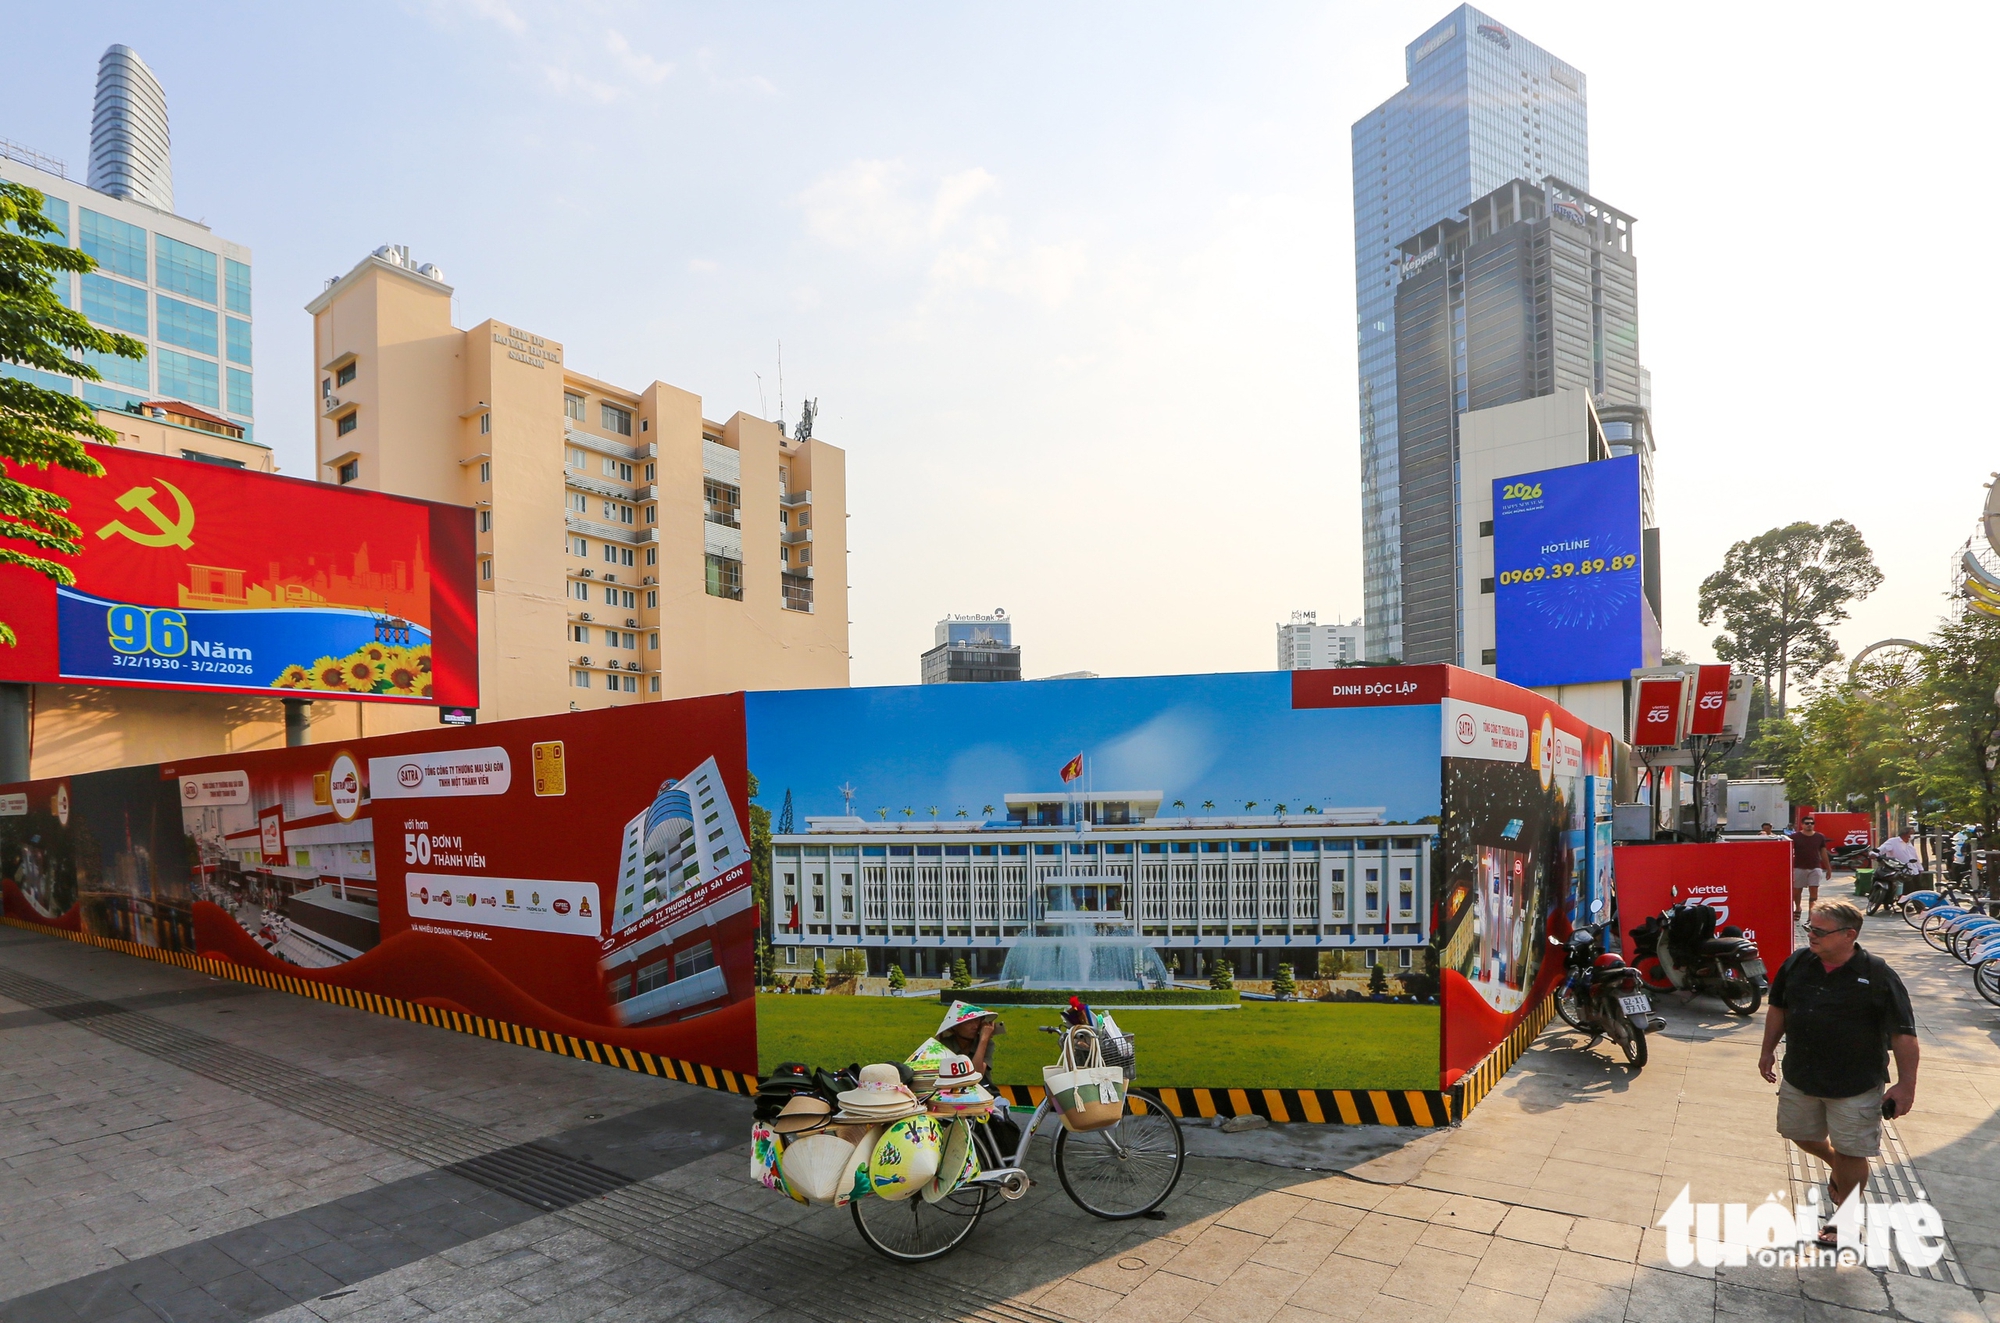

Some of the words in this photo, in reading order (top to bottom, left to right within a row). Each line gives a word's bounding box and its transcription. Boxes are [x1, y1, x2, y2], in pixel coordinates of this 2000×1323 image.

[1402, 246, 1437, 274] Keppel
[508, 327, 530, 343] KIM
[493, 333, 527, 352] ROYAL
[529, 345, 560, 364] HOTEL
[508, 350, 545, 369] SAIGON
[1502, 482, 1543, 501] 2026
[1541, 539, 1591, 555] HOTLINE
[1499, 553, 1637, 586] 0969.39.89.89
[954, 613, 995, 622] VietinBank
[1303, 611, 1317, 619] MB
[106, 604, 189, 658] 96
[190, 639, 253, 662] Năm
[112, 654, 181, 670] 3/2/1930
[191, 660, 254, 675] 3/2/2026
[1332, 685, 1362, 696] DINH
[1364, 681, 1393, 697] ĐỘC
[1395, 680, 1418, 696] LẬP
[1699, 695, 1723, 709] 5G
[1647, 709, 1669, 723] 5G
[1458, 720, 1474, 737] SATRA
[401, 770, 419, 781] SATRA
[404, 819, 414, 830] với
[415, 819, 429, 830] hơn
[432, 834, 452, 848] ĐƠN
[452, 836, 462, 851] VỊ
[1843, 834, 1869, 847] 5G
[404, 833, 431, 866] 50
[433, 851, 463, 867] THÀNH
[464, 852, 486, 868] VIÊN
[1687, 885, 1729, 894] viettel
[623, 924, 638, 937] TỔNG
[638, 915, 654, 928] CÔNG
[655, 910, 664, 920] TY
[665, 895, 692, 915] THƯƠNG
[693, 886, 709, 899] MẠI
[710, 878, 724, 891] SÀI
[725, 867, 744, 882] GÒN
[411, 923, 418, 931] VÀ
[418, 924, 434, 934] NHIỀU
[433, 926, 453, 936] DOANH
[452, 929, 473, 940] NGHIỆP
[950, 1060, 971, 1076] BOY
